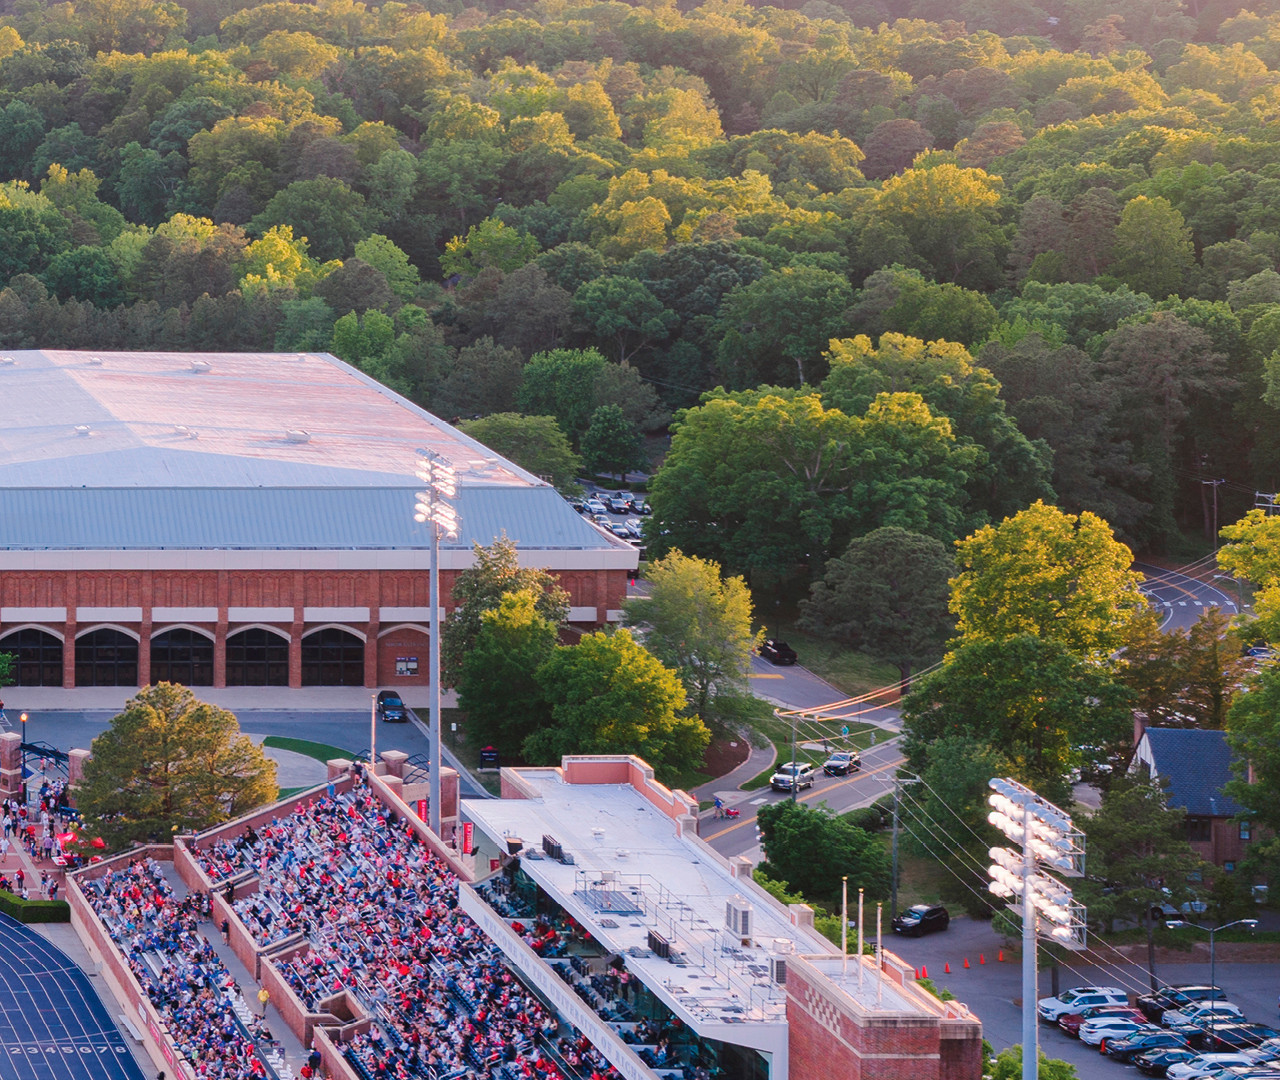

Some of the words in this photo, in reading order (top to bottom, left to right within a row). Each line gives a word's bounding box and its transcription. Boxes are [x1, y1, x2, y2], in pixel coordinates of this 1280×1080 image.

[9, 1046, 21, 1054] 2
[27, 1046, 39, 1054] 3
[45, 1046, 56, 1054] 4
[61, 1046, 74, 1054] 5
[79, 1046, 92, 1054] 6
[96, 1046, 108, 1054] 7
[115, 1046, 127, 1054] 8
